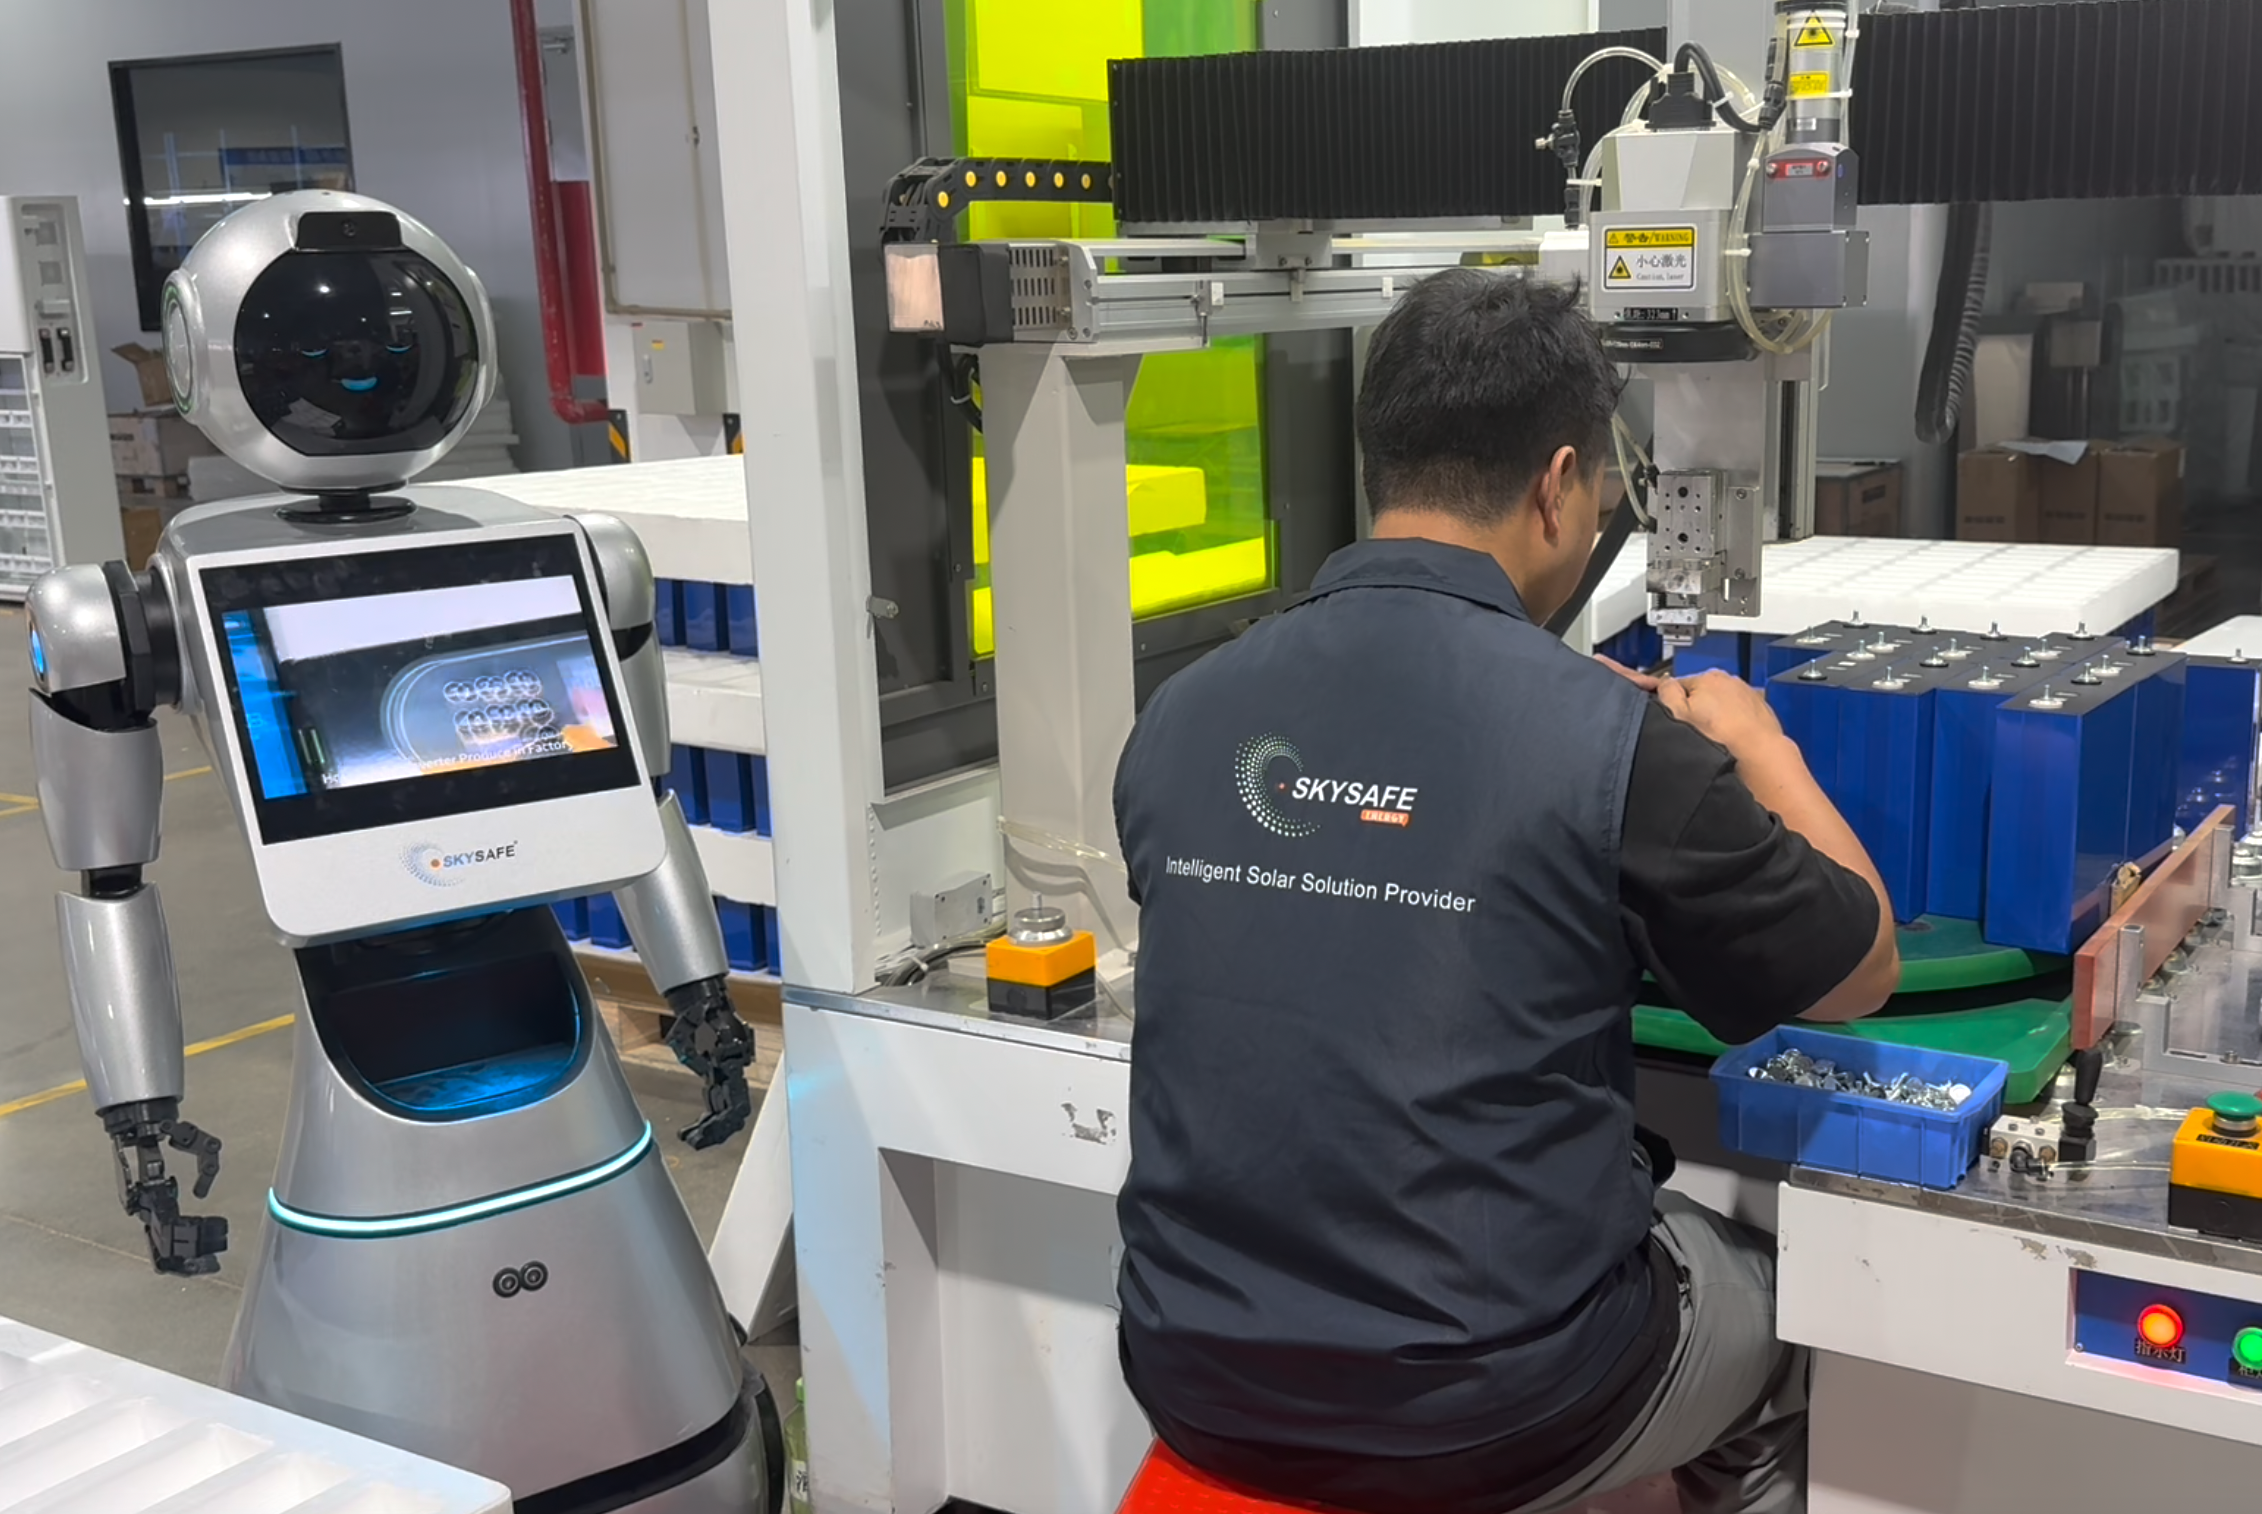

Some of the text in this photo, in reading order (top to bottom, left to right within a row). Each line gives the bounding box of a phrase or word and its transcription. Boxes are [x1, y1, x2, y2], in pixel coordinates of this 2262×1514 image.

[1636, 254, 1687, 268] 小心激光
[460, 747, 512, 763] Produce
[528, 739, 574, 757] Factory
[1292, 777, 1418, 811] SKYSAFE
[1364, 810, 1406, 823] ENERGY
[443, 844, 516, 868] SKYSAFE
[1166, 856, 1476, 912] Intelligent Solar Solution Provider
